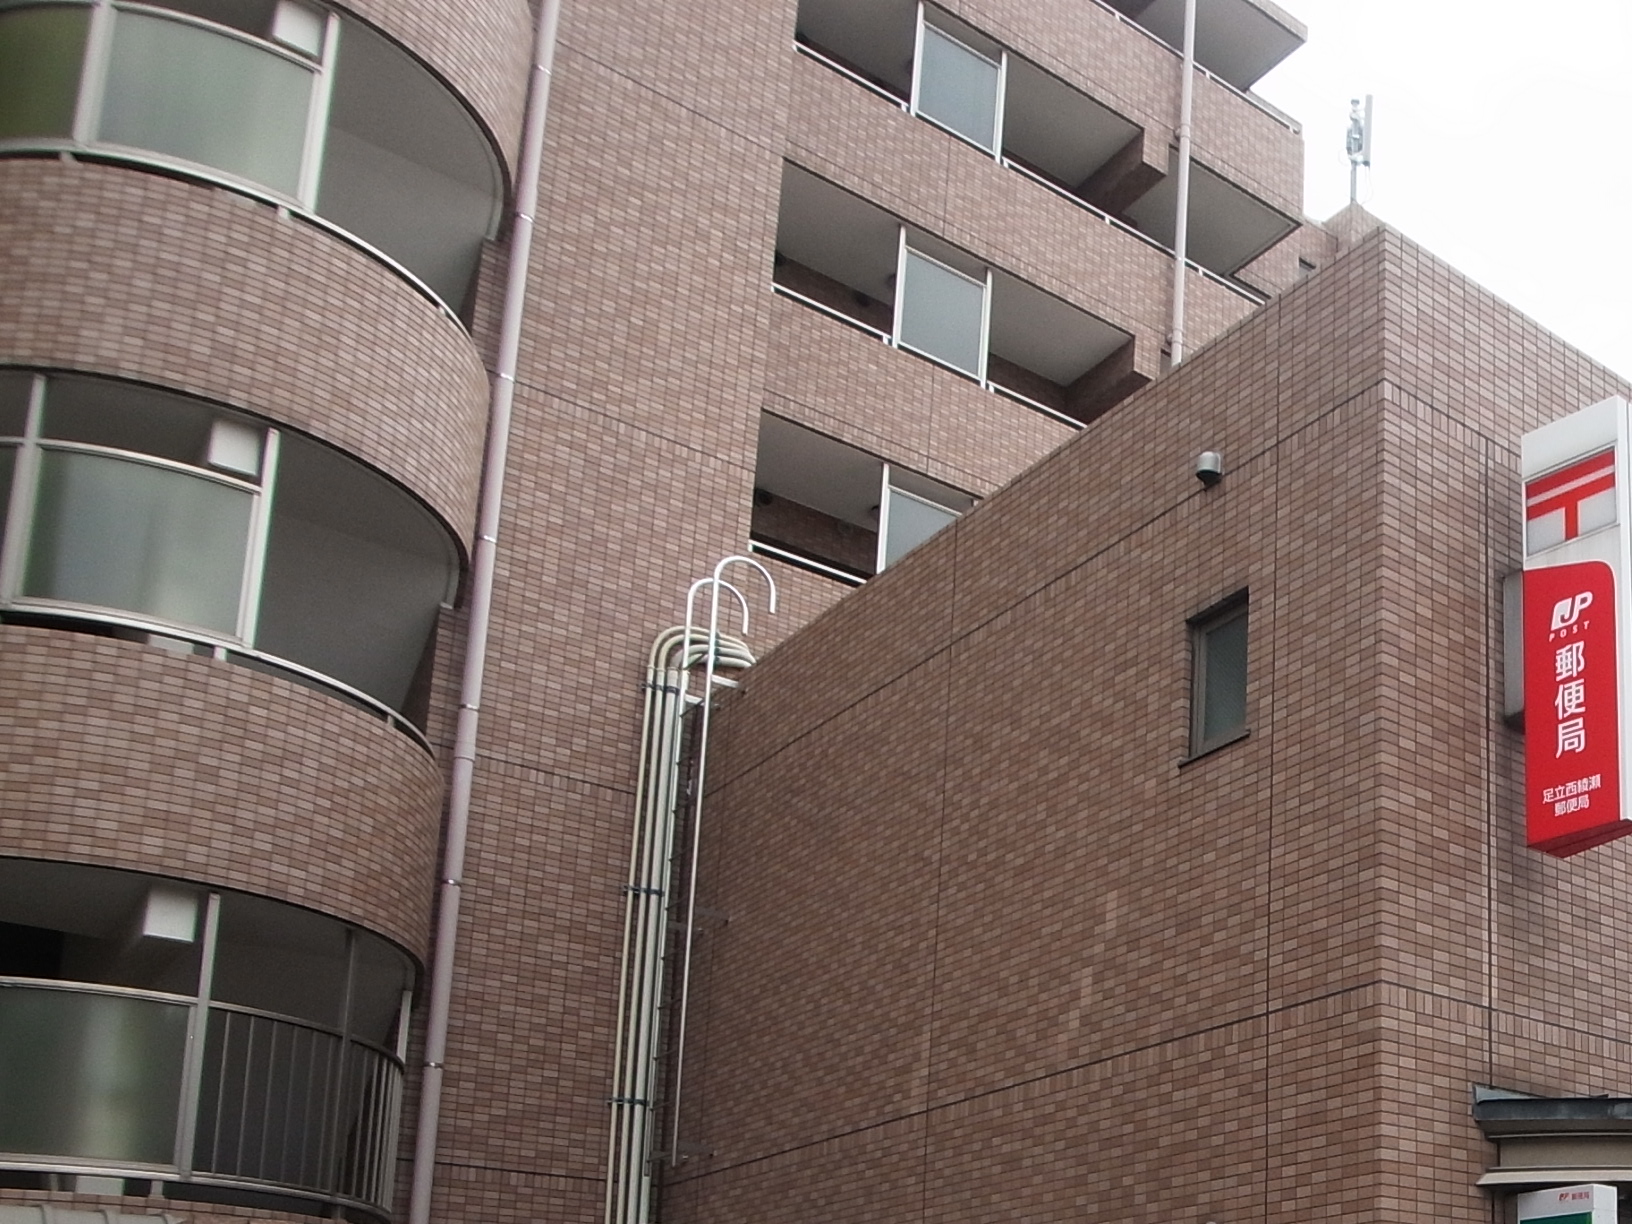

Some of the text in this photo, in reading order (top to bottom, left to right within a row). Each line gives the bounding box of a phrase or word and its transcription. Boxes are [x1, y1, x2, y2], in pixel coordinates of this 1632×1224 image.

[1549, 620, 1590, 642] POST
[1555, 640, 1586, 759] 郵便局
[1542, 773, 1602, 804] 足立西綾瀬
[1554, 794, 1590, 817] 郵便局
